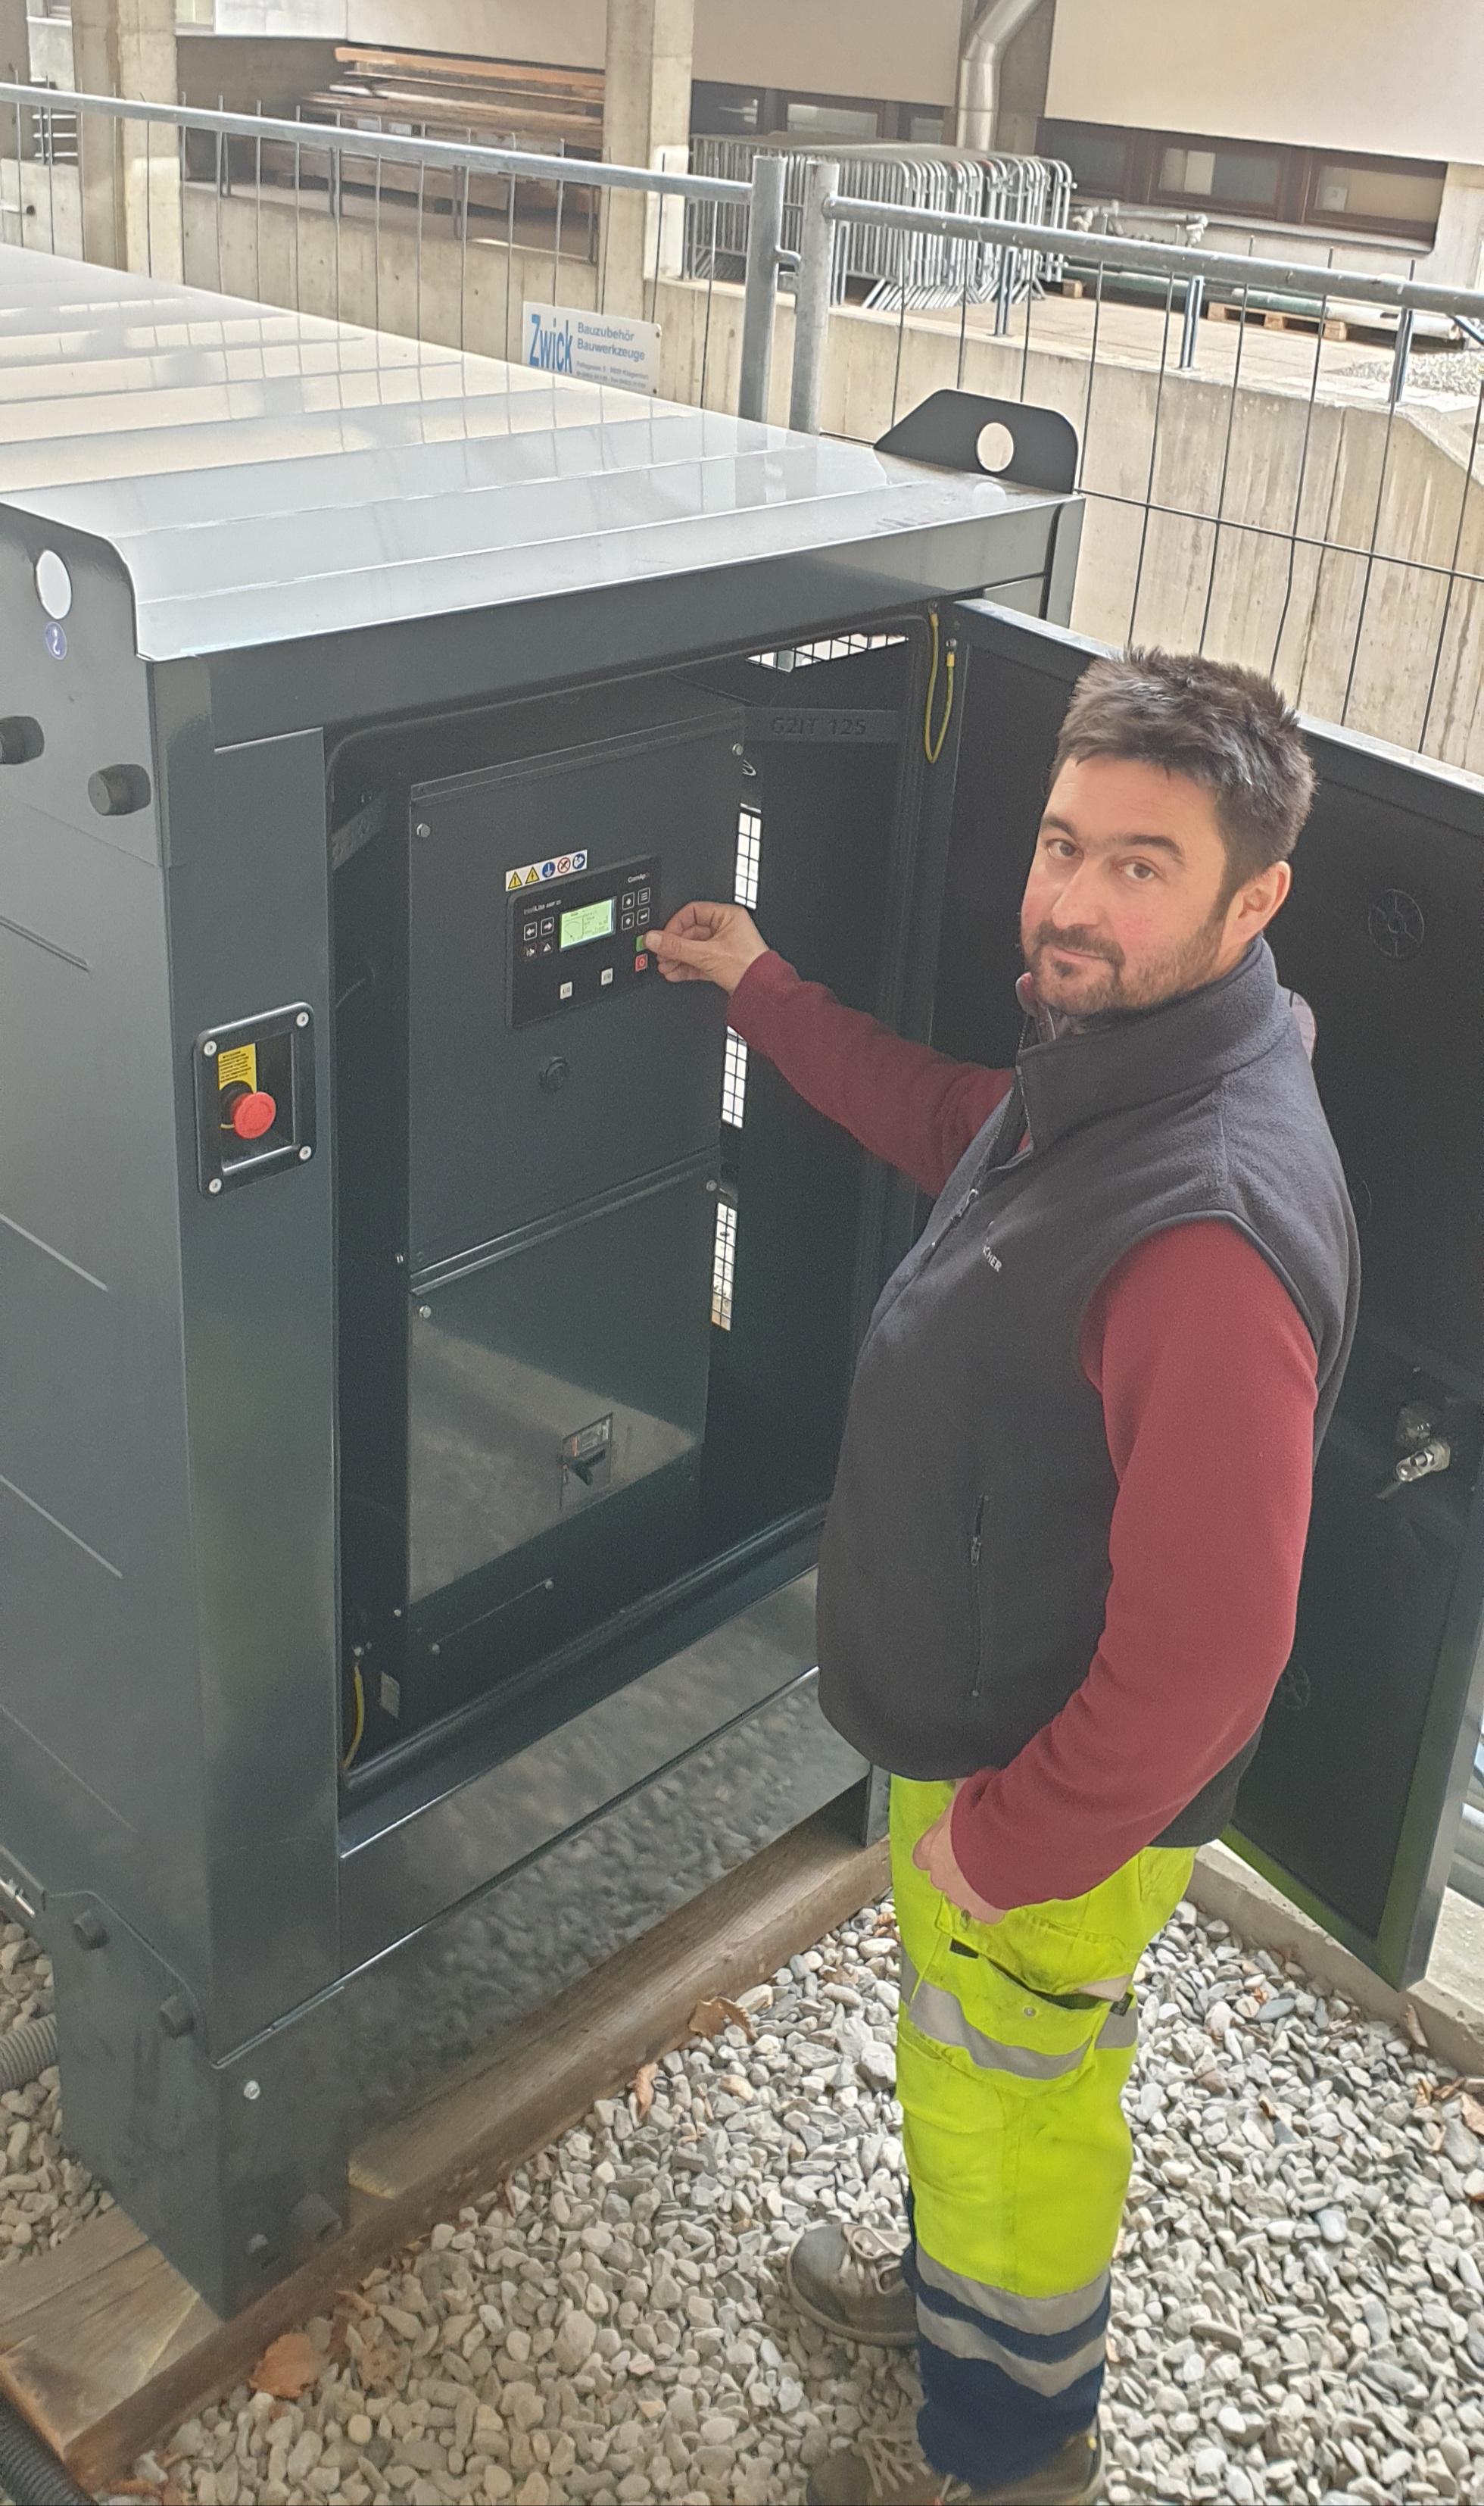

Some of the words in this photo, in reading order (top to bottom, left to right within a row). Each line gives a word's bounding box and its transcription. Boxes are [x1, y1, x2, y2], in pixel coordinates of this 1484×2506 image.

[577, 322, 635, 342] Bauzubehör
[529, 314, 573, 374] Zwick
[576, 338, 646, 362] Bauwerkzeuge
[828, 718, 867, 735] 125
